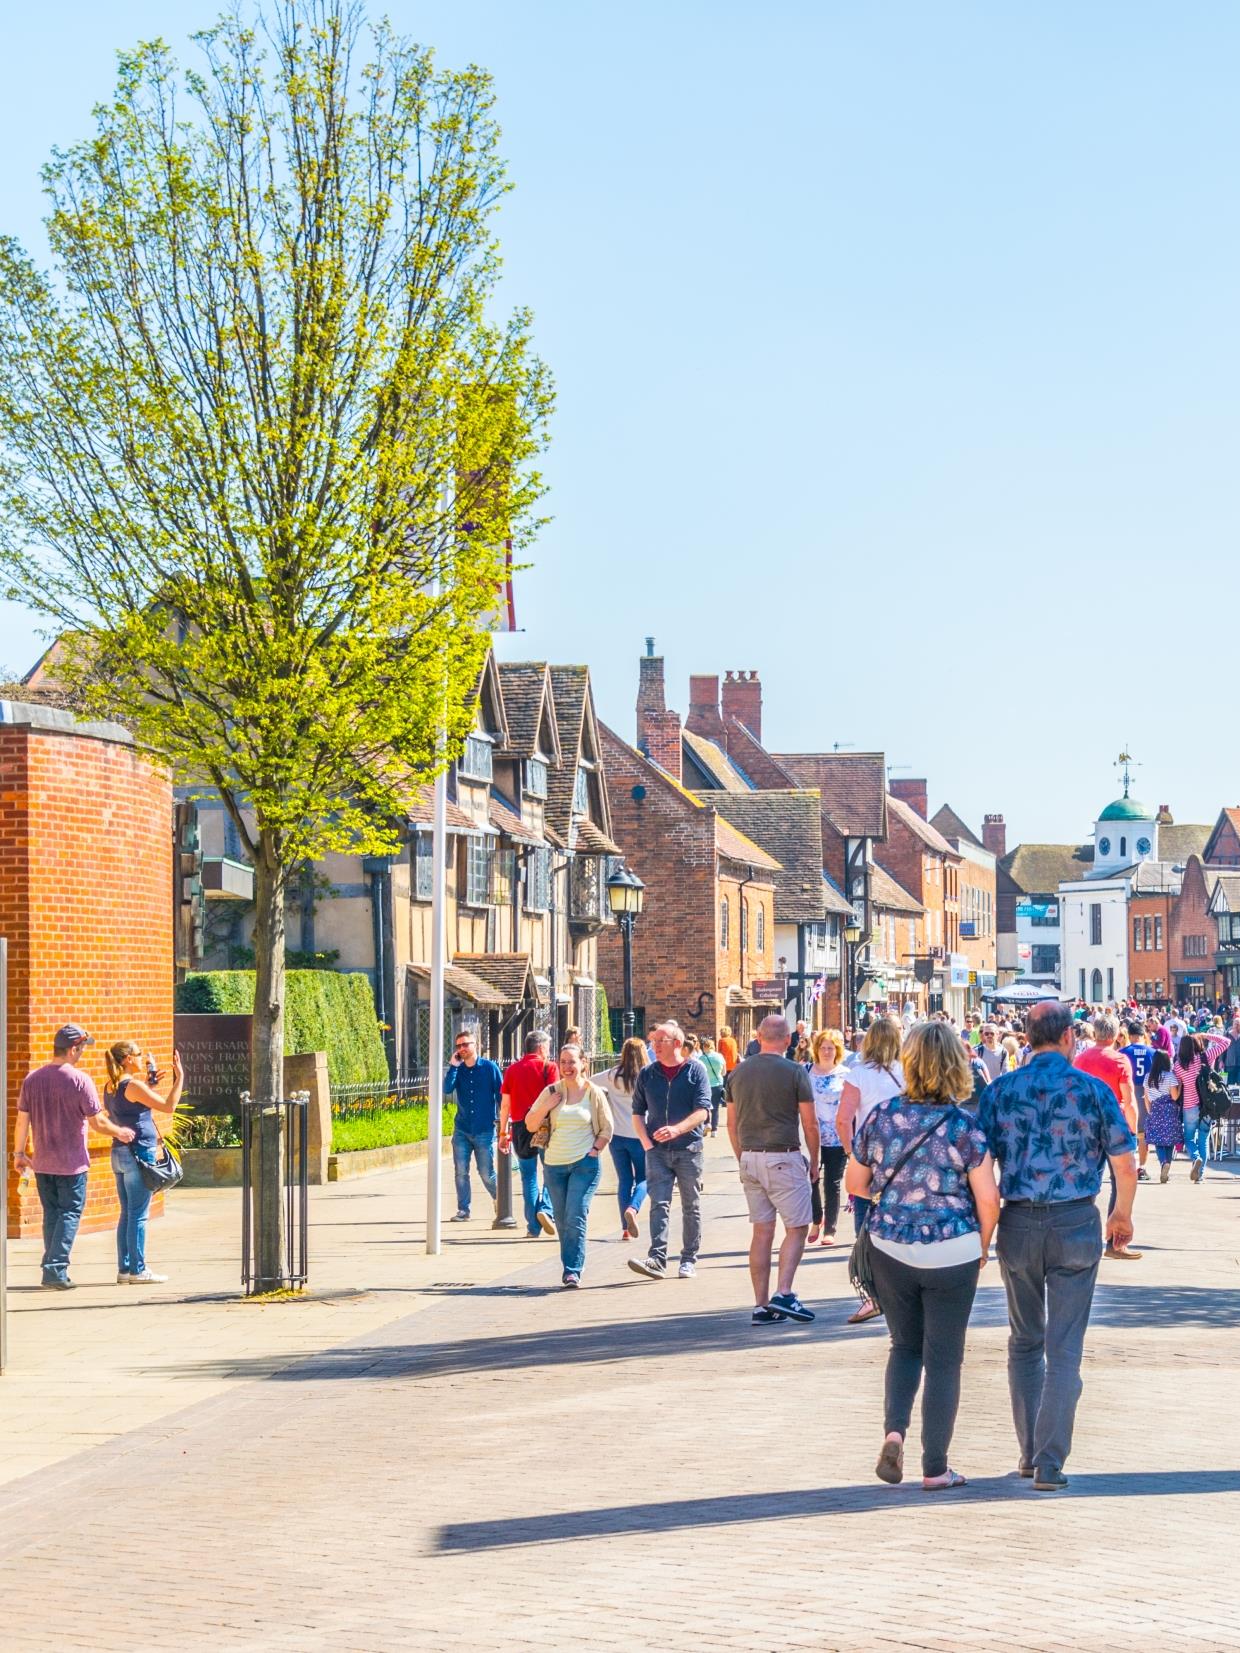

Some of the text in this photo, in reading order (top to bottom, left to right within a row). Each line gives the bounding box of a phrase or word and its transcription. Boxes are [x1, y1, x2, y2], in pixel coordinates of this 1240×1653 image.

[178, 1041, 249, 1050] NNIVERSARY
[1136, 1058, 1145, 1077] 5
[189, 1075, 250, 1084] HIGHNESS
